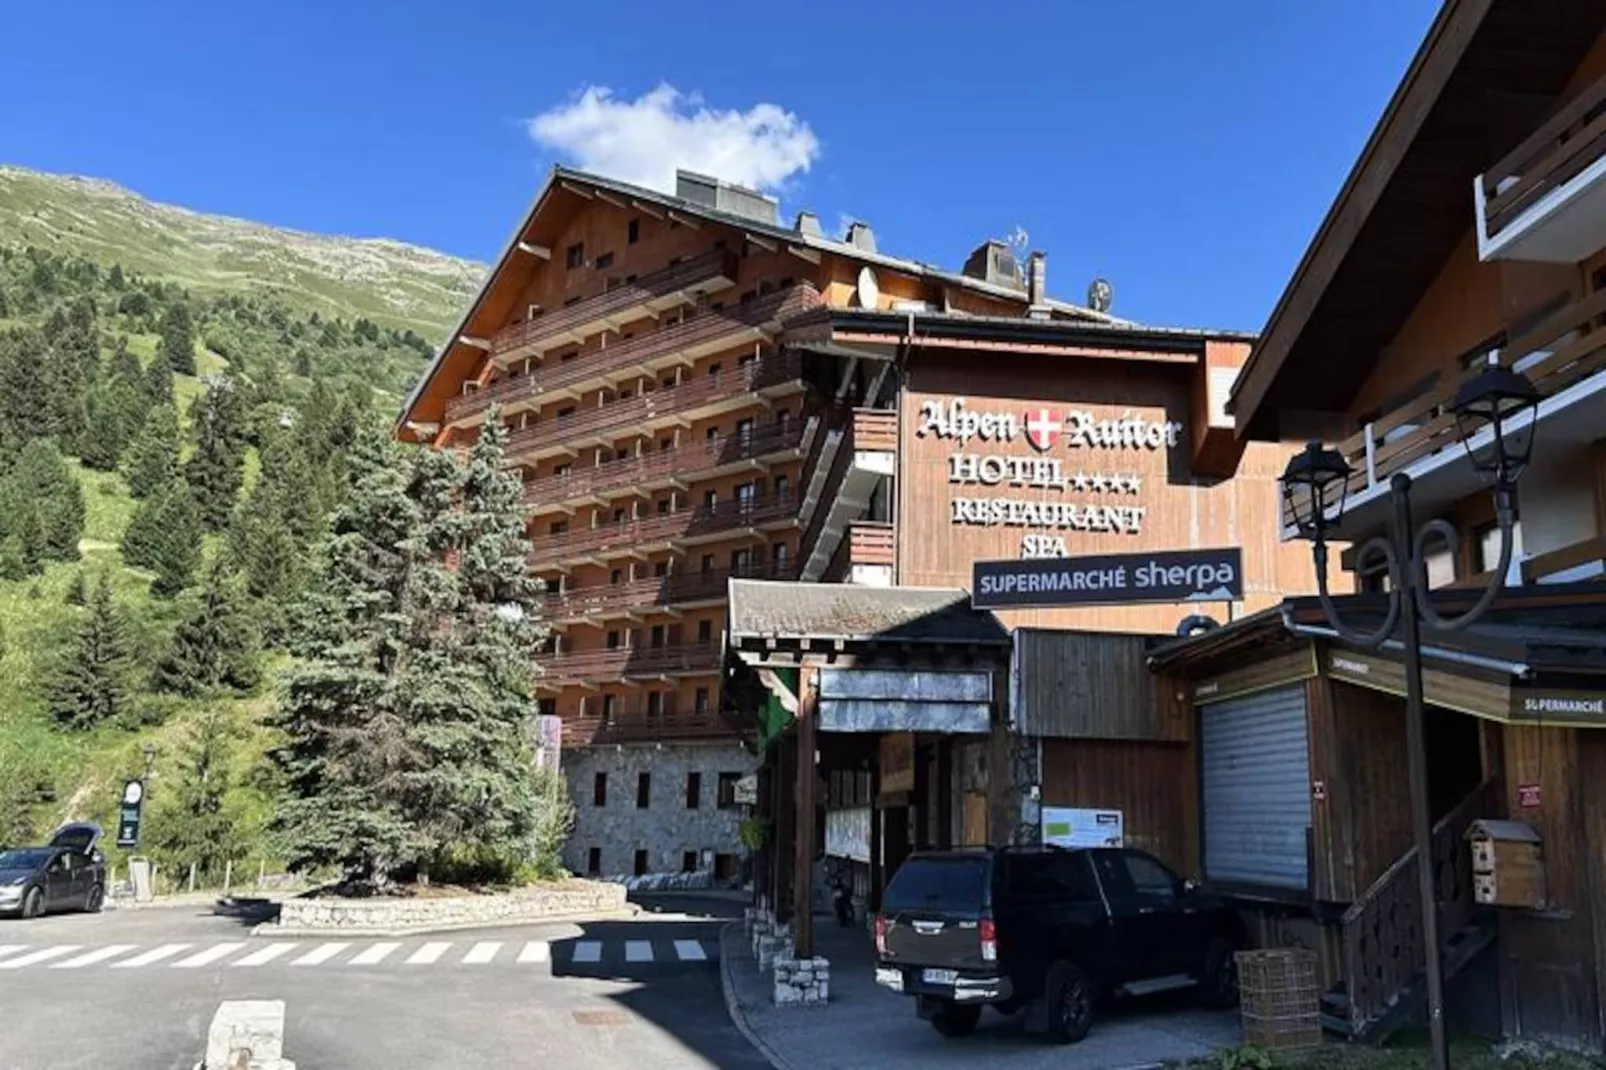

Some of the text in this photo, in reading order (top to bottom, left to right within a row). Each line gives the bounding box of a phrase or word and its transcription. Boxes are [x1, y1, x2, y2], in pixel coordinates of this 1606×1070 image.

[917, 397, 1018, 444] Alpen
[951, 453, 1065, 487] HOTEL
[953, 496, 1146, 531] RESTAURANT
[1022, 533, 1069, 560] SPA
[980, 560, 1234, 594] SUPERMARCHÉ sherpa
[1524, 697, 1604, 714] SUPERMARCHÉ
